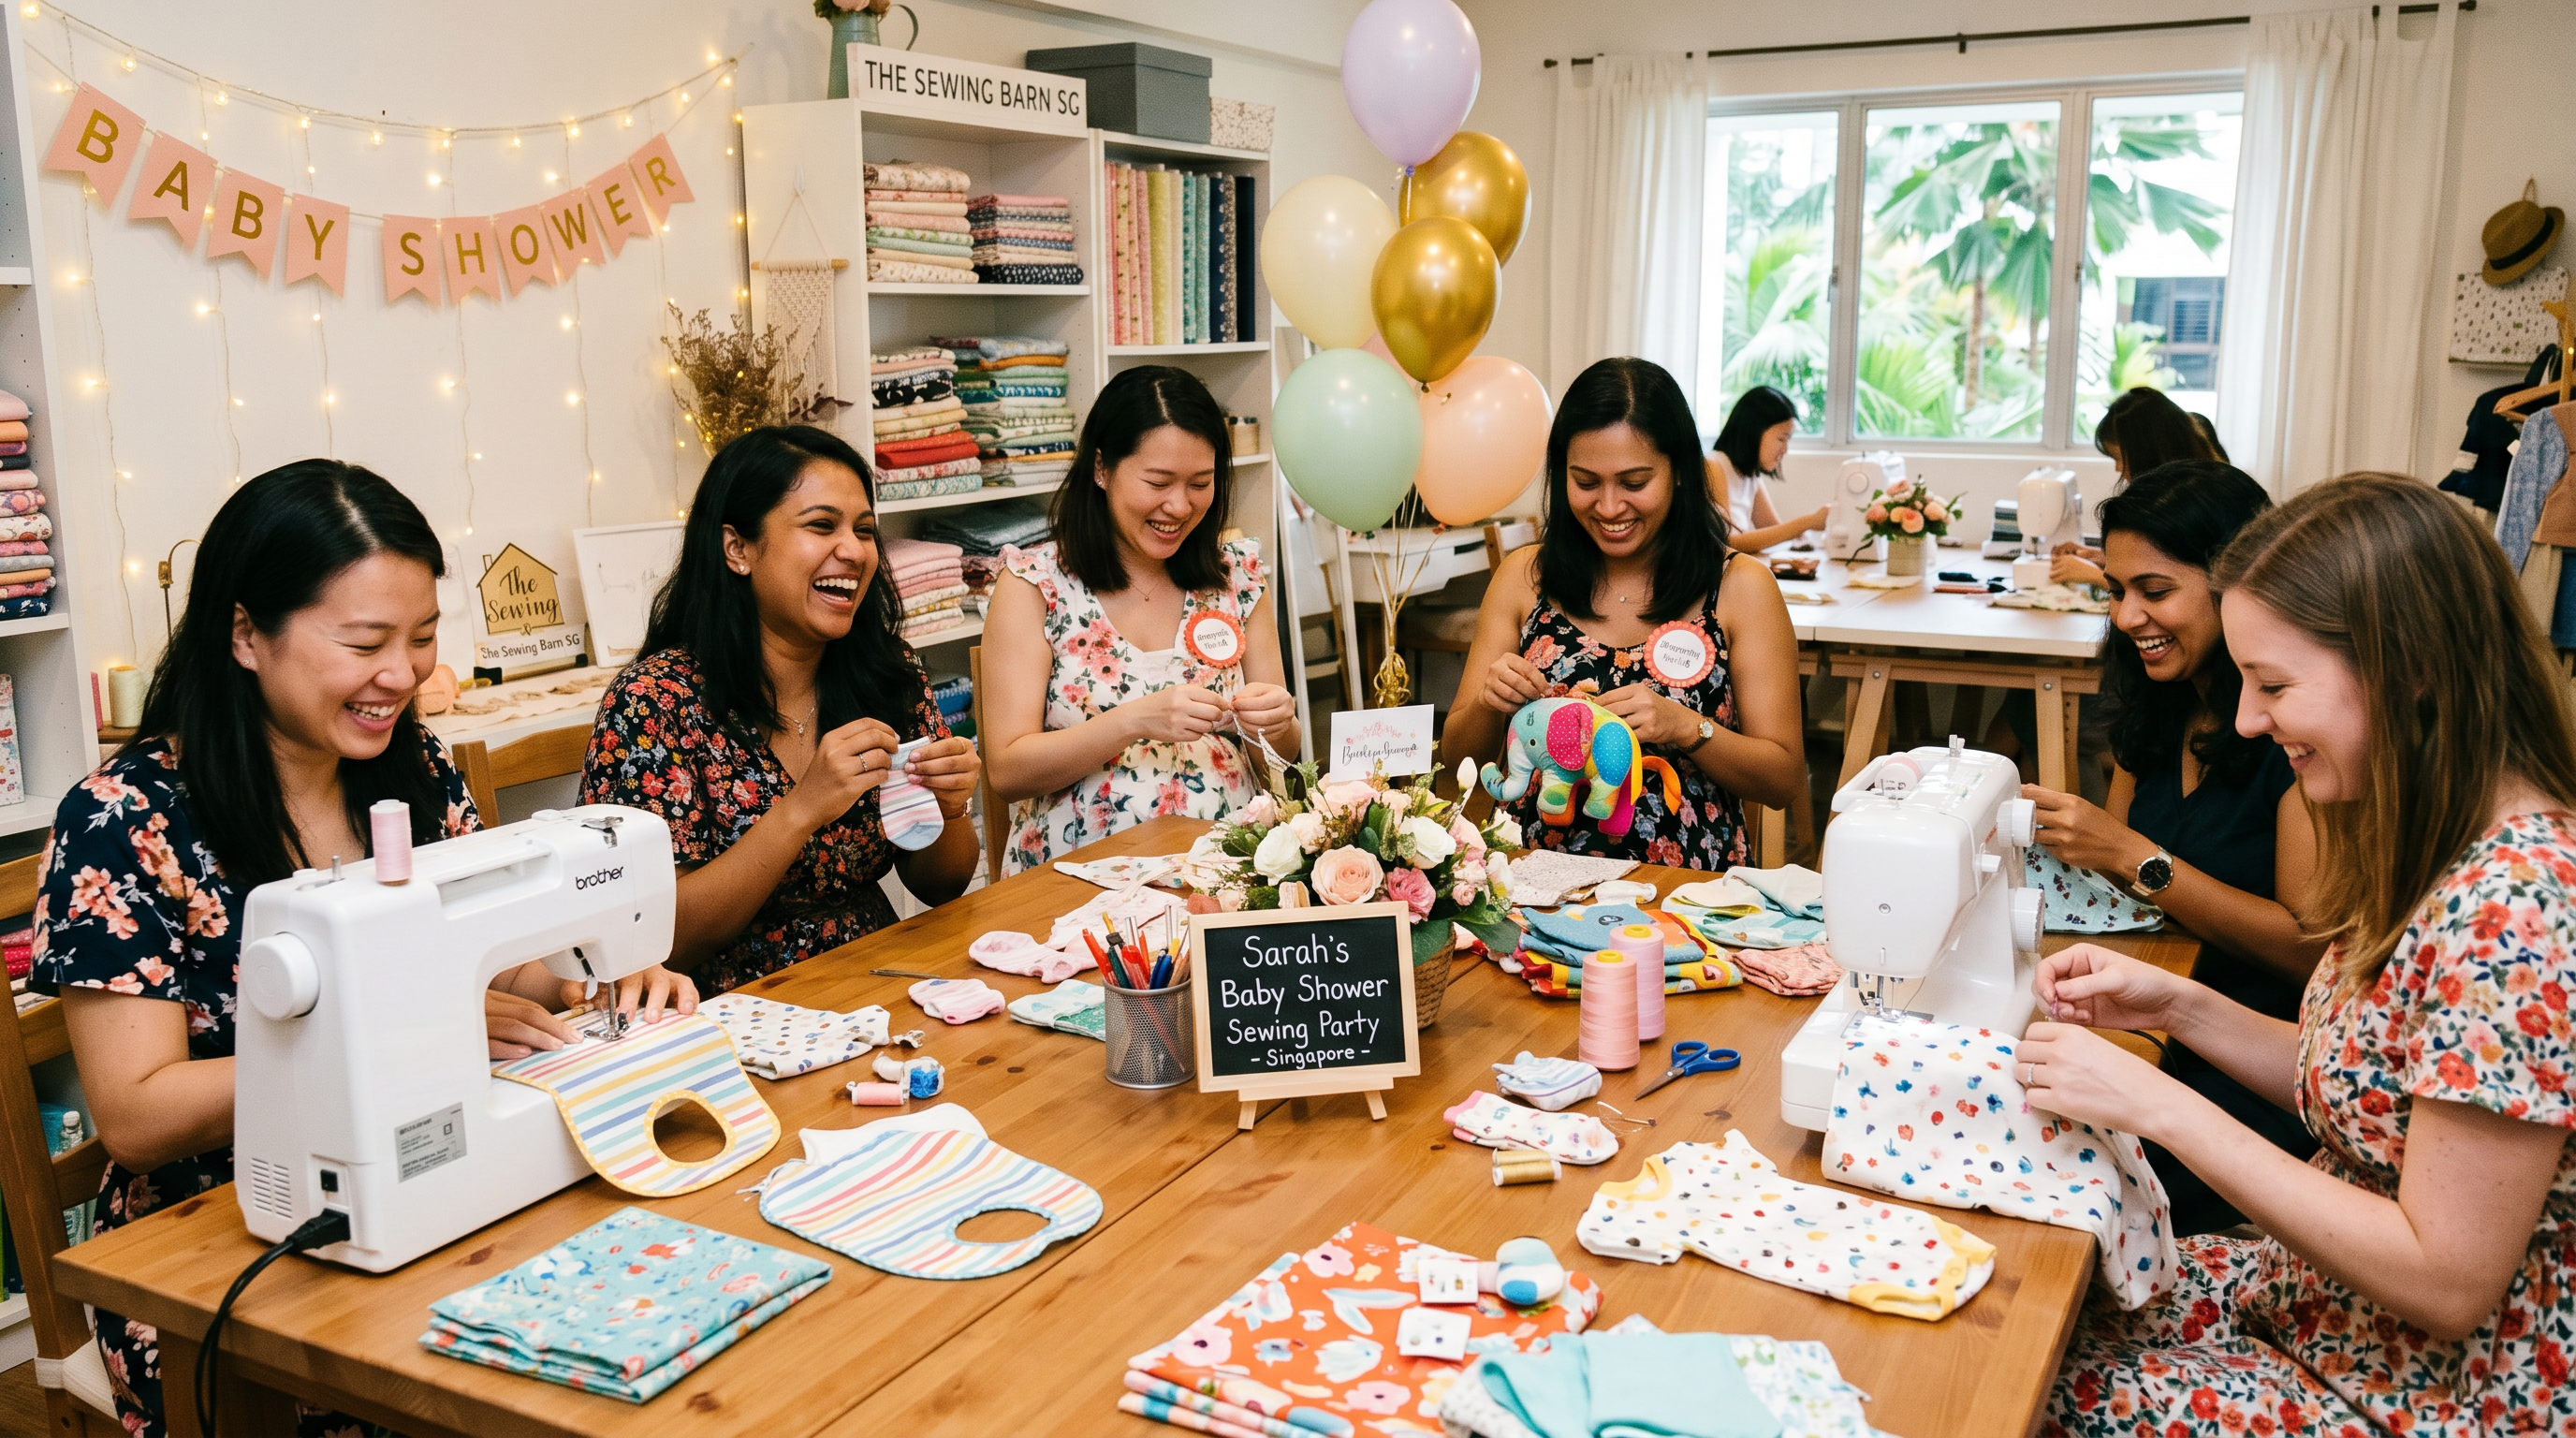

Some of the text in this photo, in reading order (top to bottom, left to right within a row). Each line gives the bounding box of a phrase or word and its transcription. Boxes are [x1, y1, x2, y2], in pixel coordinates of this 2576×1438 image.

[865, 60, 1080, 116] THE SEWING BARN SG
[76, 109, 677, 276] BABY SHOWER
[499, 565, 538, 596] The
[487, 596, 559, 624] Sewing
[501, 643, 538, 657] Sewing
[539, 638, 564, 652] Barn
[565, 633, 580, 647] SG
[575, 866, 624, 890] brother
[1242, 933, 1350, 968] Sarah's
[1221, 974, 1389, 1016] Baby Shower
[1226, 1009, 1380, 1049] Sewing Party
[1266, 1047, 1355, 1070] Singapore
